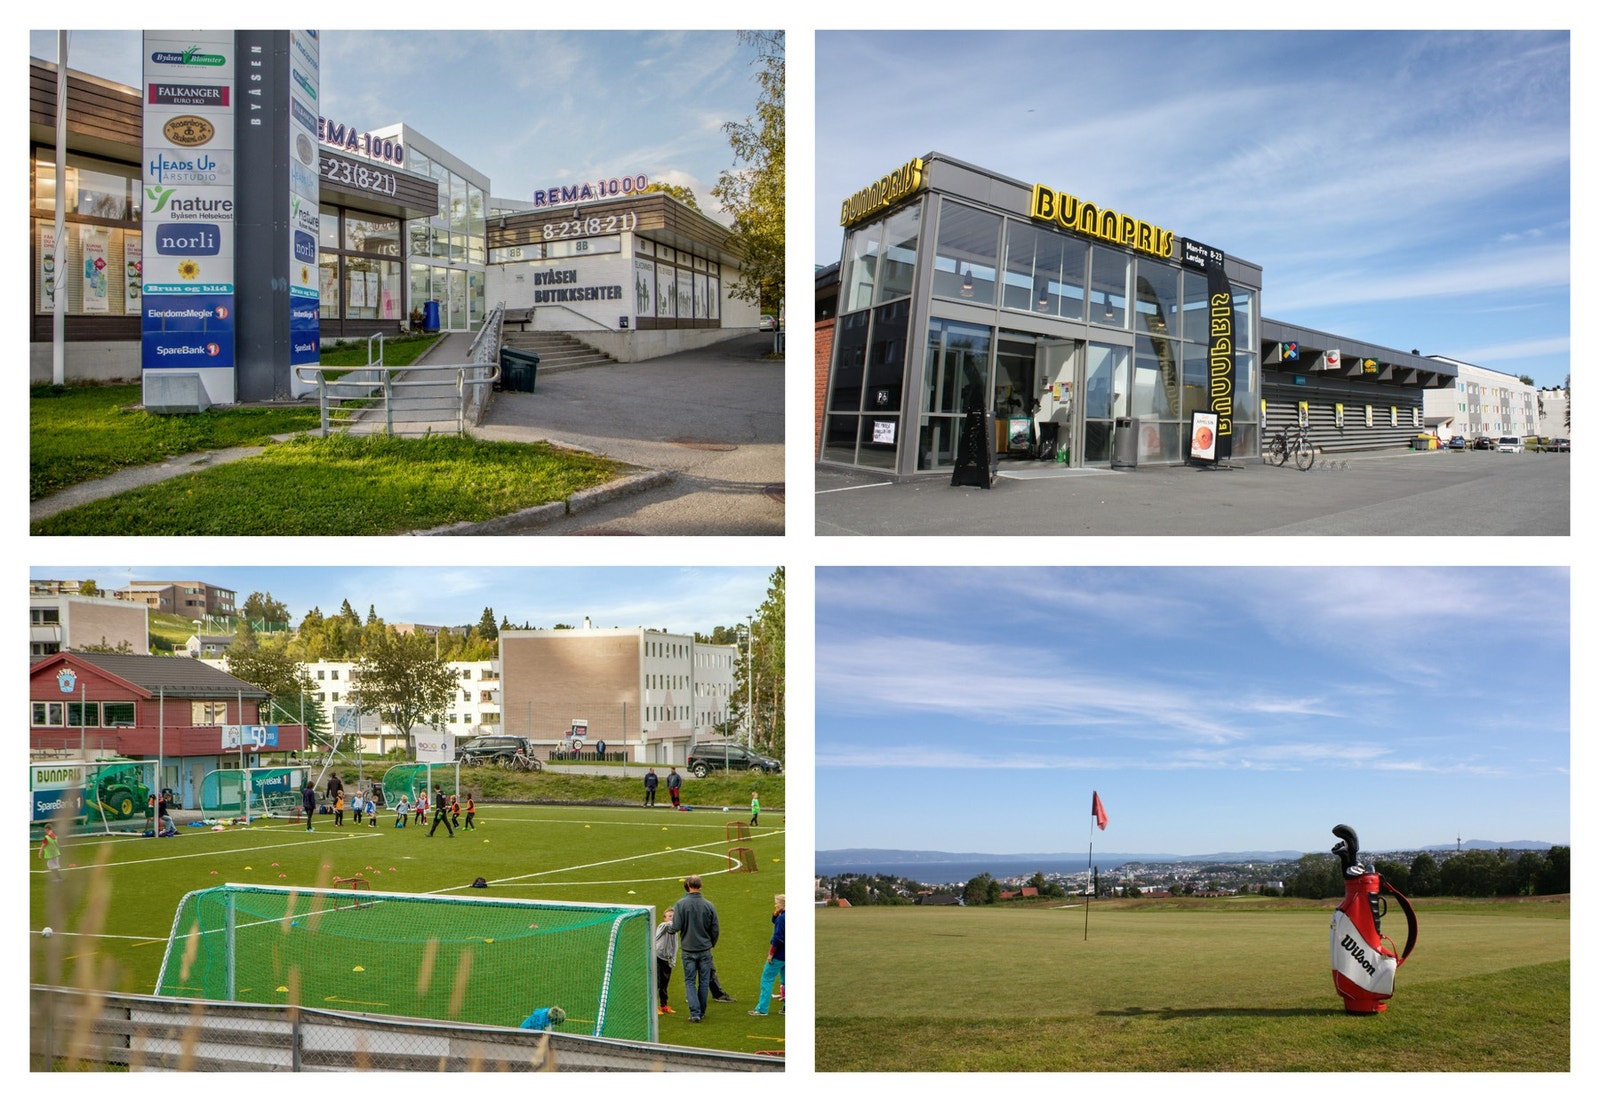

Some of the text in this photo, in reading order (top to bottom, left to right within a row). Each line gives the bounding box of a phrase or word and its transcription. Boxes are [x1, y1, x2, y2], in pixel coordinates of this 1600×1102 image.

[156, 53, 222, 64] Byåsen Blomster
[158, 87, 220, 98] FALKANGER
[248, 46, 262, 126] BYÅSEN
[169, 119, 208, 133] Rosenborg
[318, 115, 360, 151] EMA
[363, 132, 404, 165] 1000
[318, 158, 397, 197] -23(8-21)
[533, 173, 648, 207] REMA 1000
[840, 157, 923, 226] BUNNPRIS
[170, 196, 233, 212] nature
[170, 212, 233, 221] Byåsen Helsekost
[543, 211, 637, 240] 8-23(8-21)
[1031, 183, 1174, 258] BUNNPRIS
[162, 232, 214, 249] norli
[296, 242, 314, 258] norli
[1186, 242, 1222, 261] Man-Fre 8-23
[534, 268, 577, 286] BYÅSEN
[184, 285, 201, 293] og
[534, 285, 623, 303] BUTIKKSENTER
[148, 309, 213, 319] EiendomsMegler
[156, 345, 205, 356] SpareBank
[1211, 293, 1232, 436] BUNNPRIS
[250, 726, 267, 752] 50
[37, 768, 81, 783] BUNNPRIS
[1341, 934, 1376, 977] Wilson
